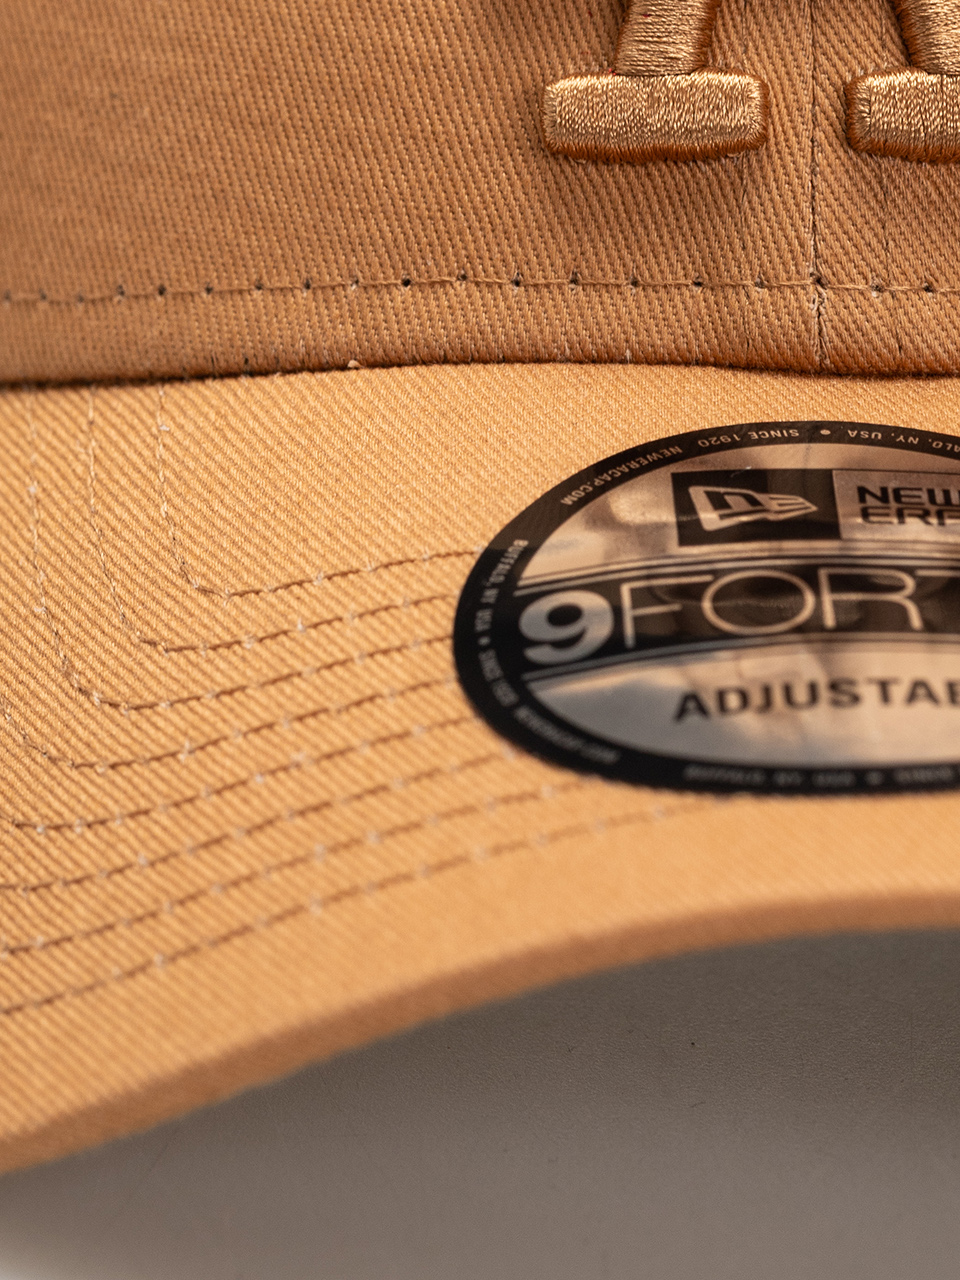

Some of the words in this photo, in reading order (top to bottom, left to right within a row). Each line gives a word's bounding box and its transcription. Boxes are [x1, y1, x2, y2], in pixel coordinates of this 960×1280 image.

[697, 432, 741, 448] 1920
[747, 429, 800, 440] SINCE
[847, 429, 882, 440] USA
[560, 445, 683, 507] NEWERACAP.COM
